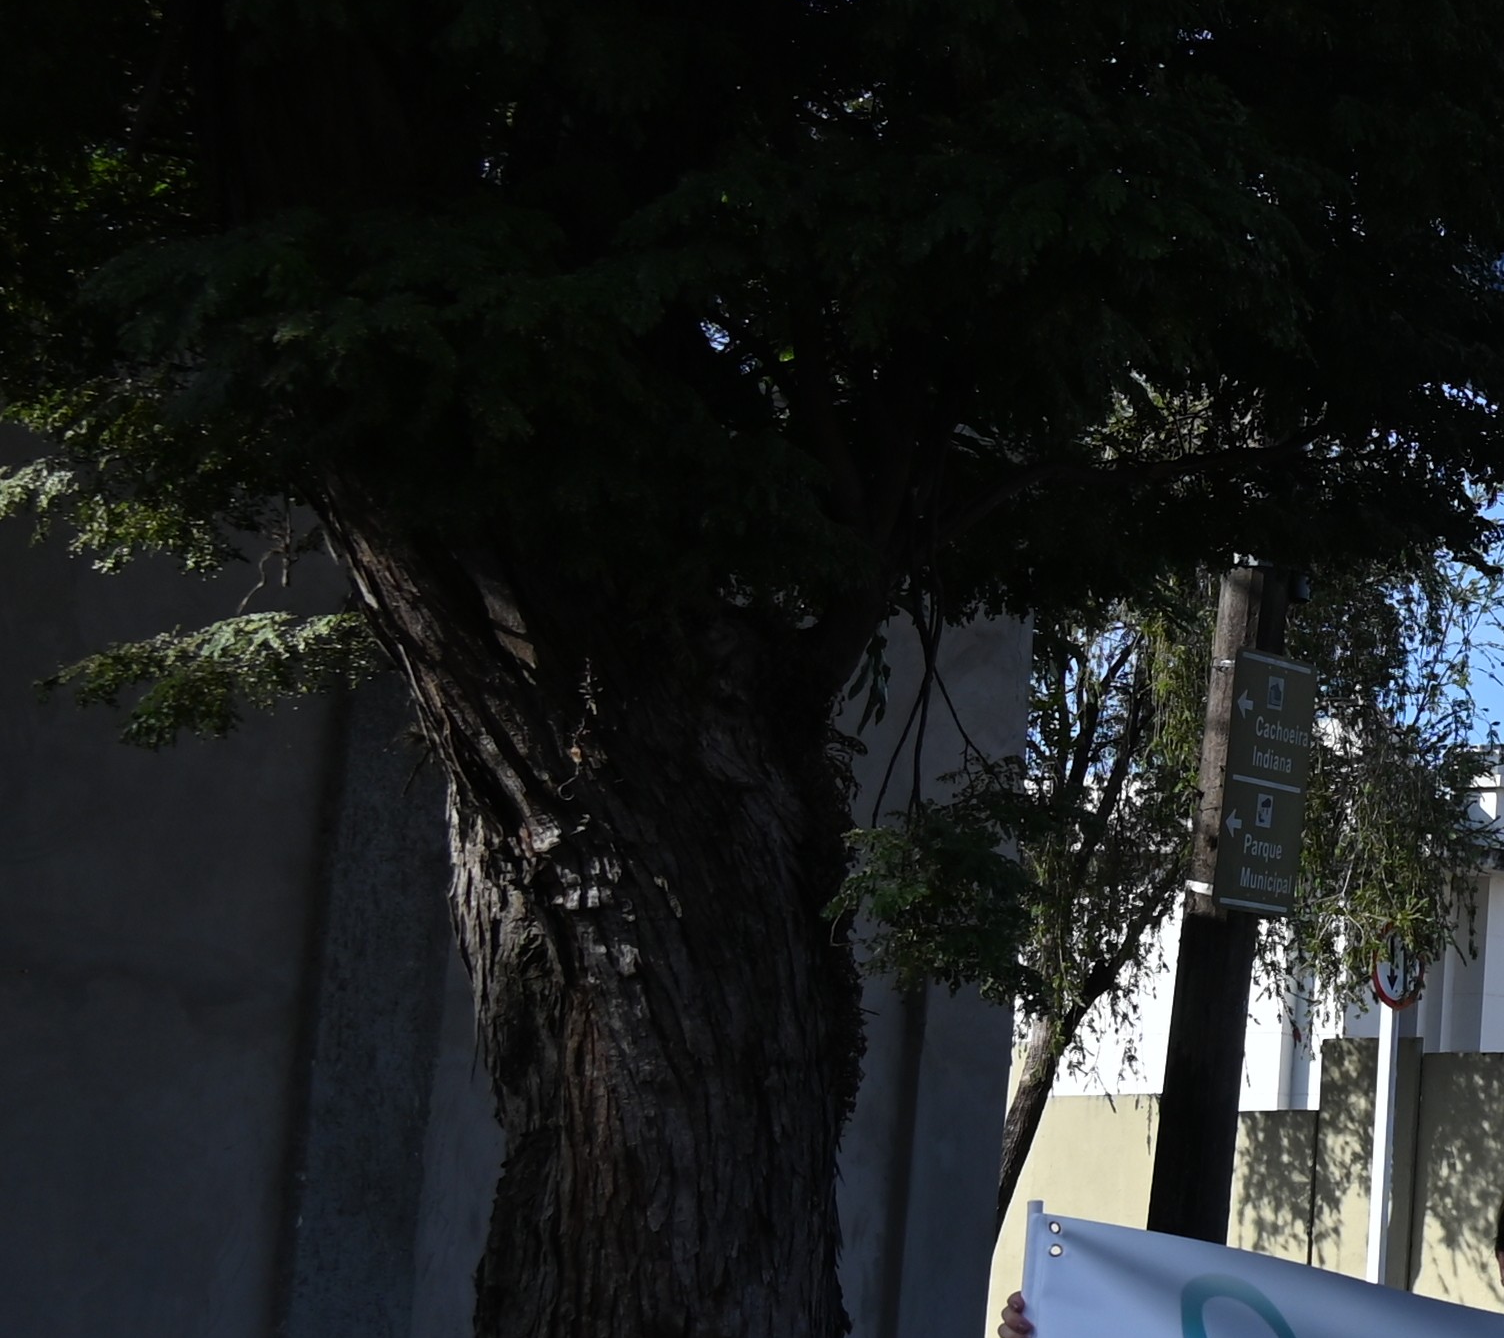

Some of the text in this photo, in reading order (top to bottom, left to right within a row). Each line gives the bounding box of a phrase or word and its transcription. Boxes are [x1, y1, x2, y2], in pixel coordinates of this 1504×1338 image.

[1255, 715, 1309, 747] Cachoeira
[1252, 745, 1292, 774] Indiana
[1243, 833, 1283, 863] Parque
[1240, 868, 1292, 898] Municipal
